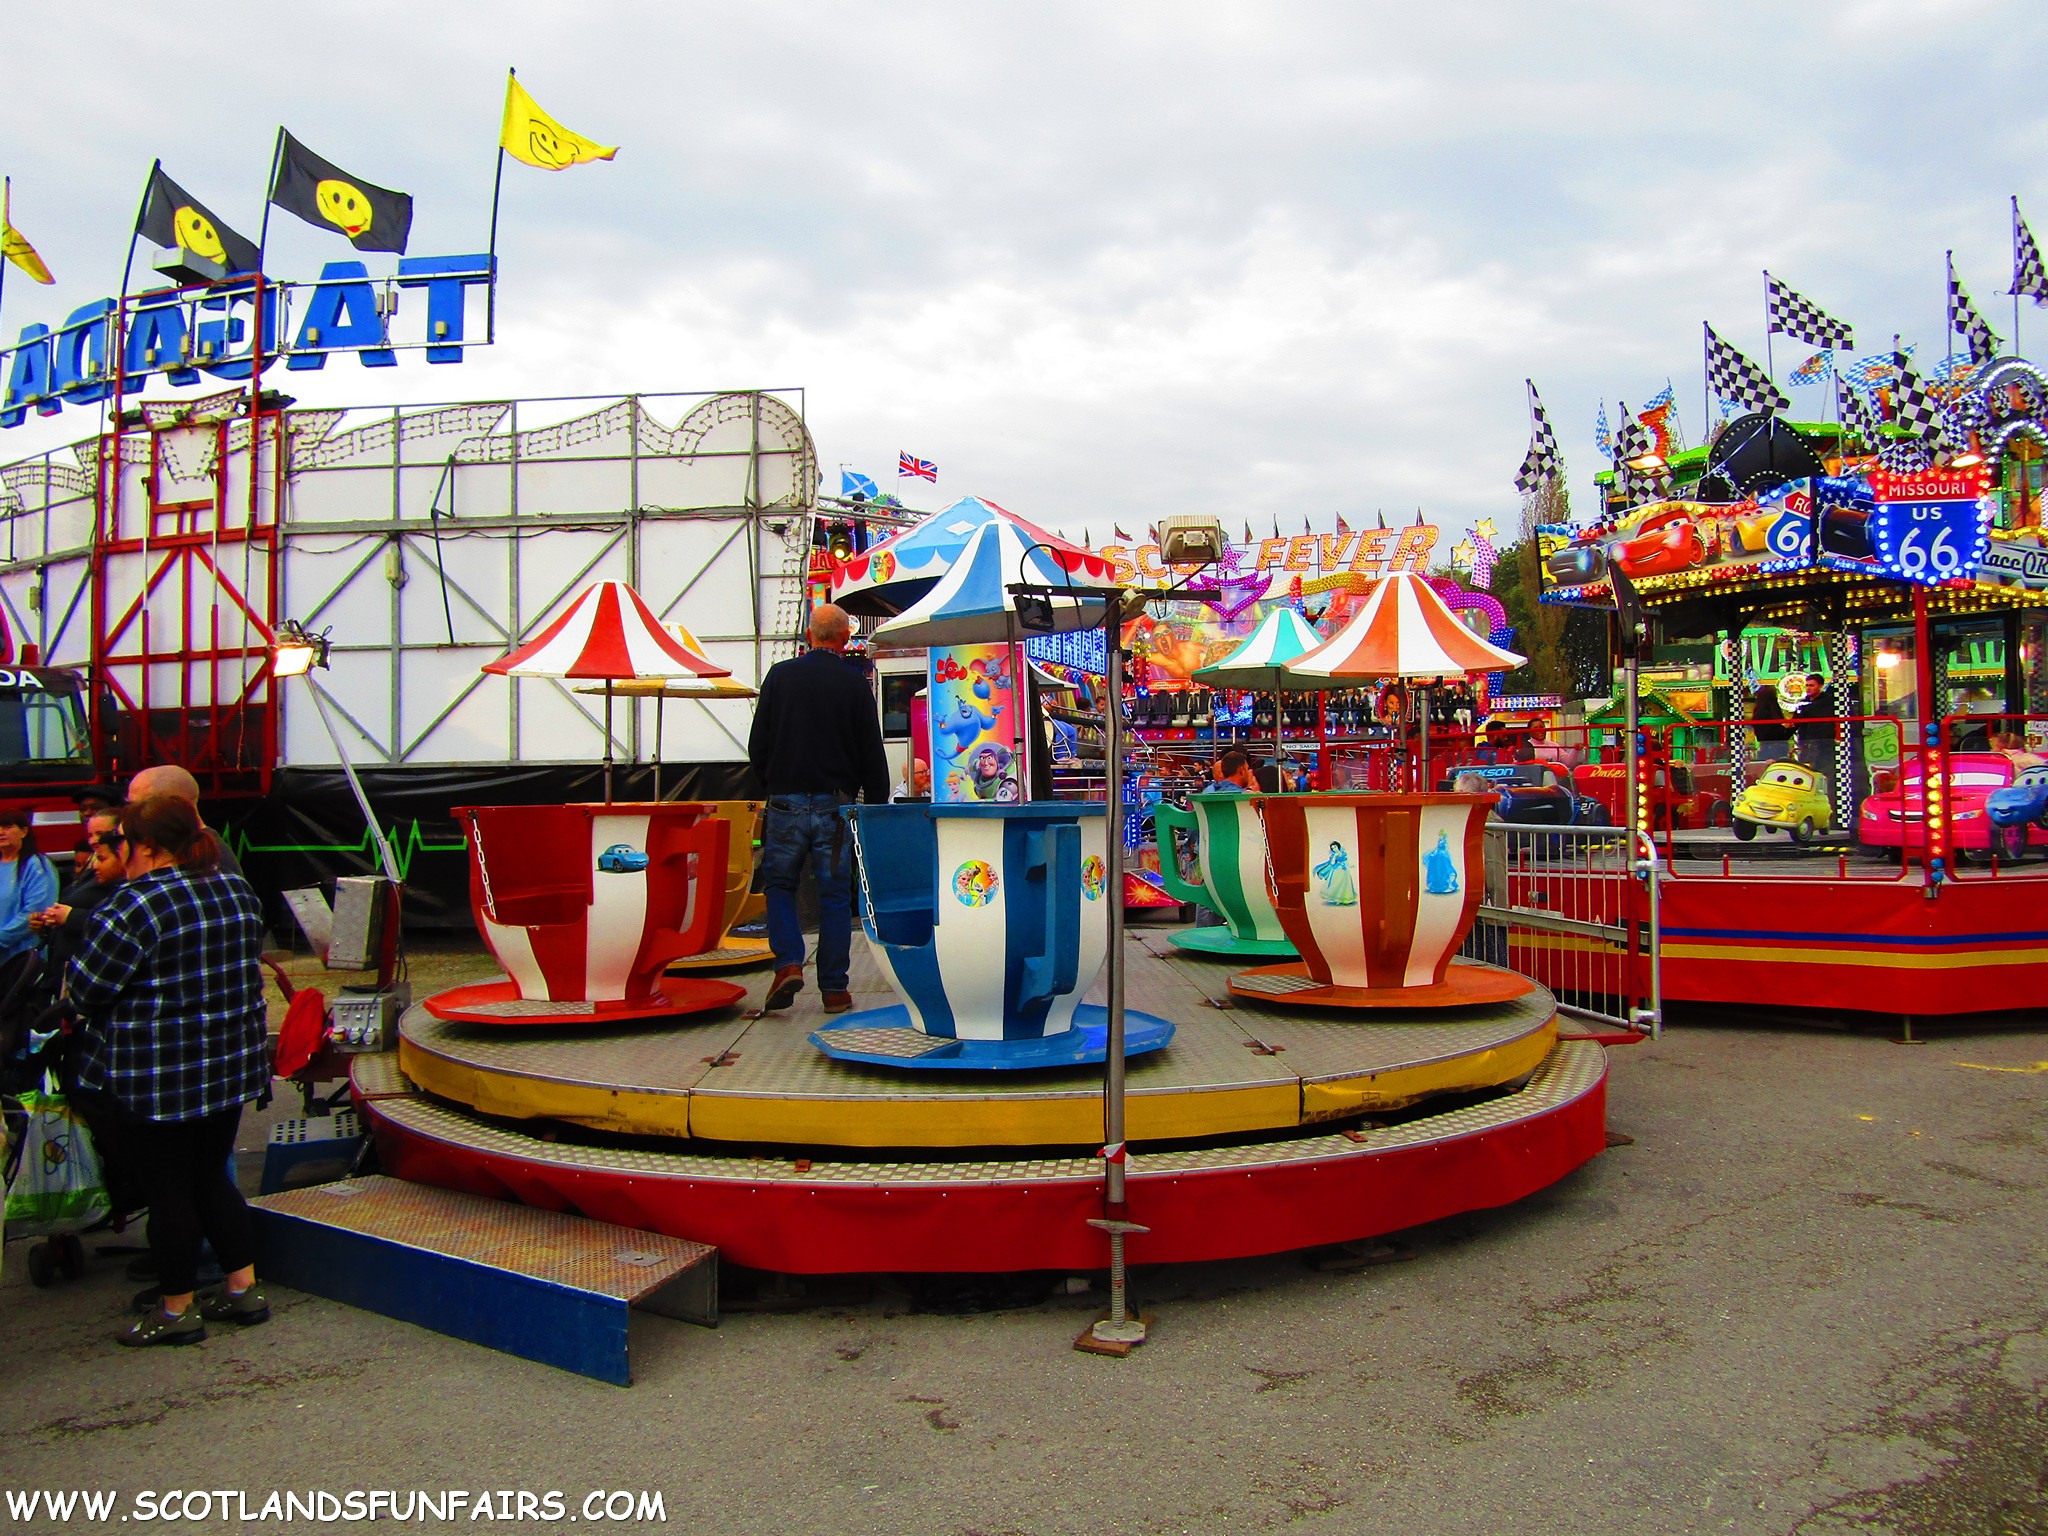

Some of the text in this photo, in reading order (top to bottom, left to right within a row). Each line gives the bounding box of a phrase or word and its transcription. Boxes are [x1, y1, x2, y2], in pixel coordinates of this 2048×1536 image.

[1888, 482, 1966, 497] MISSOURI
[1911, 506, 1943, 521] US
[1256, 524, 1441, 572] FEVER
[1899, 526, 1959, 573] 66
